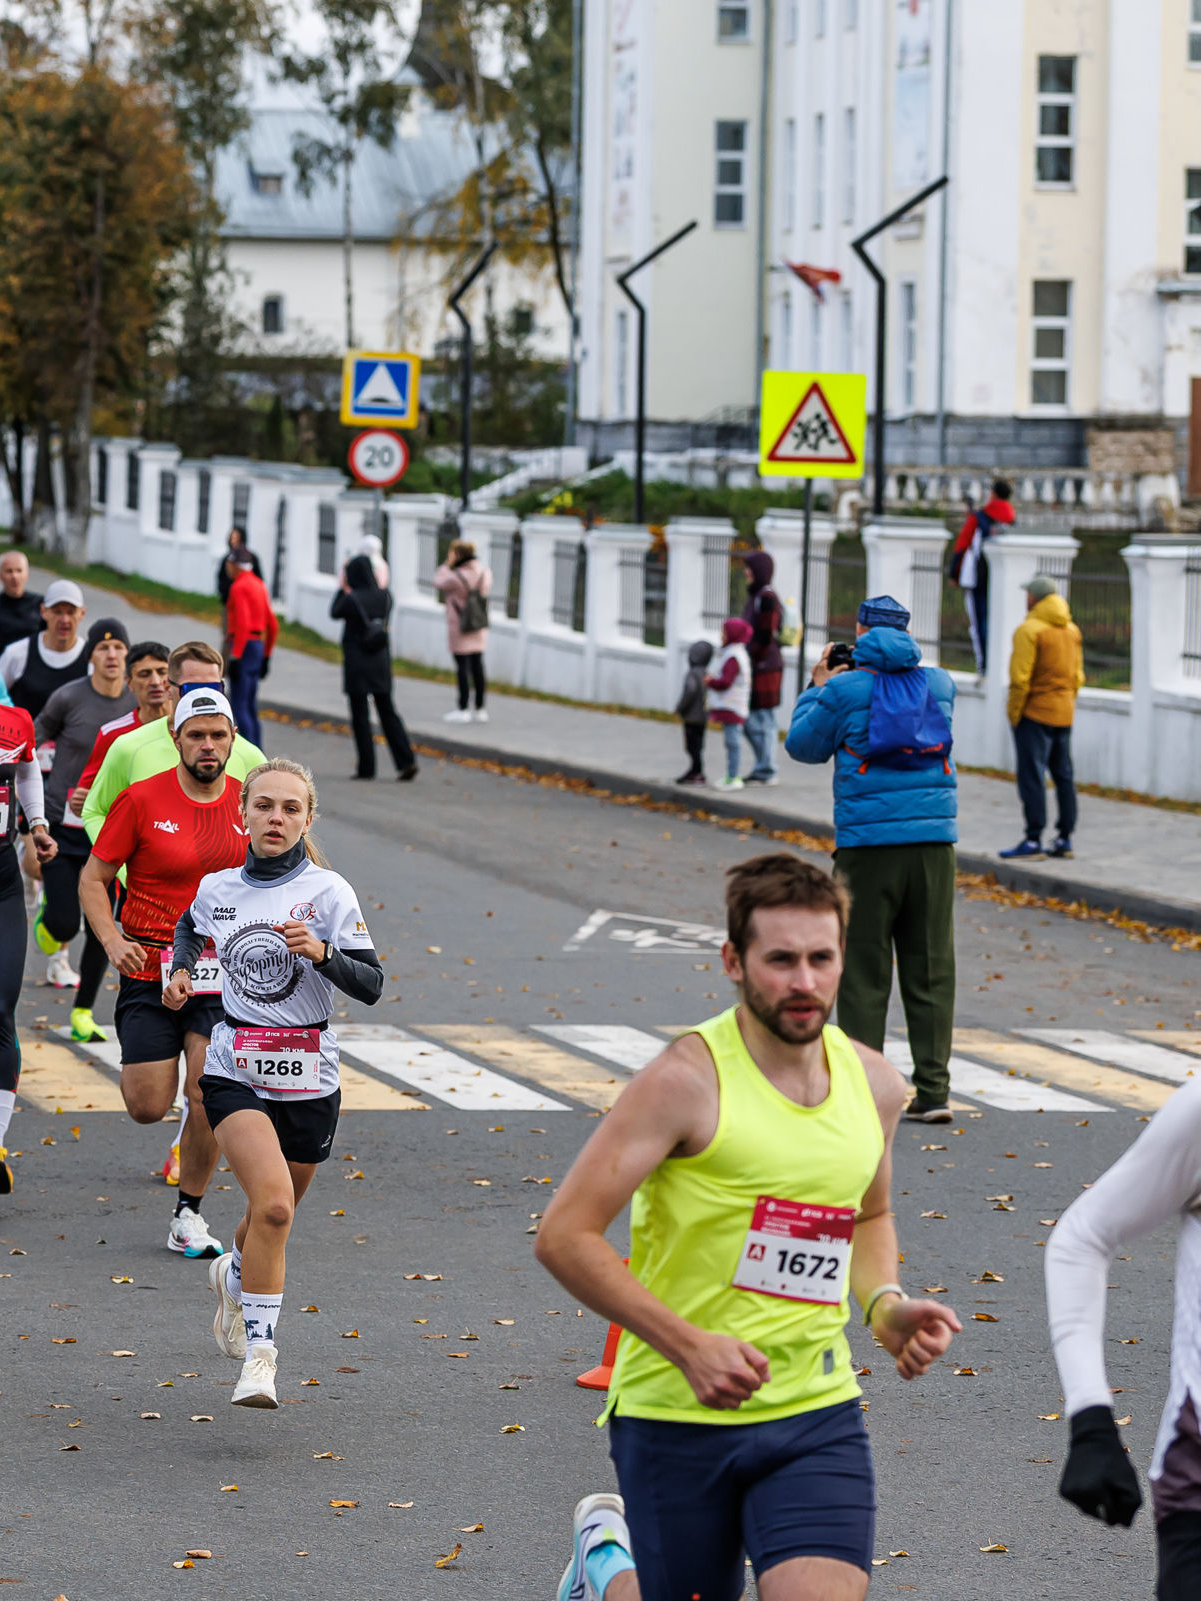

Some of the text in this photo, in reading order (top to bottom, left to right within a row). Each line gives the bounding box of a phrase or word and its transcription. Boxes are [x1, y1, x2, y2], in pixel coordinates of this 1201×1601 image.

[364, 445, 395, 469] 20
[153, 819, 180, 834] TRAIL
[190, 968, 219, 981] 327
[254, 1059, 303, 1076] 1268
[777, 1249, 839, 1280] 1672
